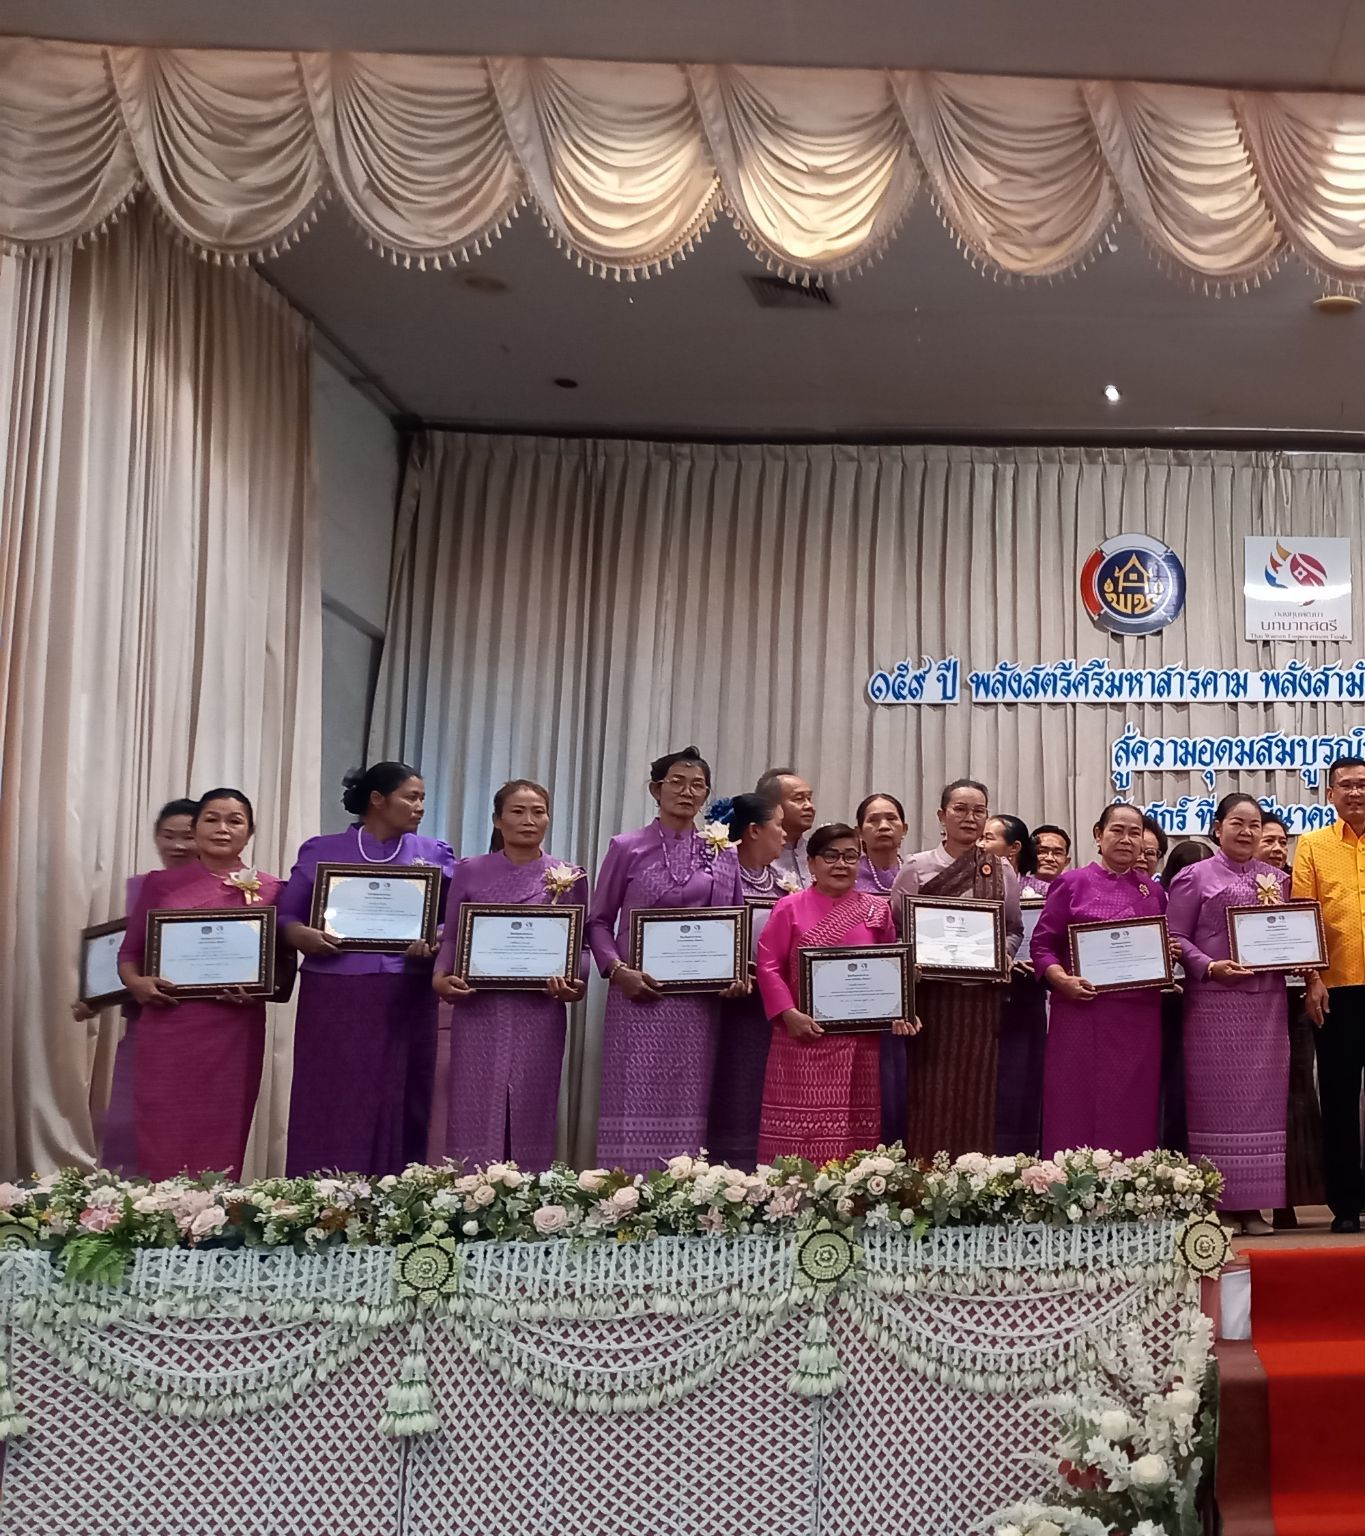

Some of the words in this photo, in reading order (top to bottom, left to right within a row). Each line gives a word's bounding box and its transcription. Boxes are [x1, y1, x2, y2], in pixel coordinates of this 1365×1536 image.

[1261, 619, 1338, 631] บทบาทสตรี
[936, 658, 958, 701] ปี
[968, 658, 1249, 700] พลังสตรีศรีมหาสารคาม
